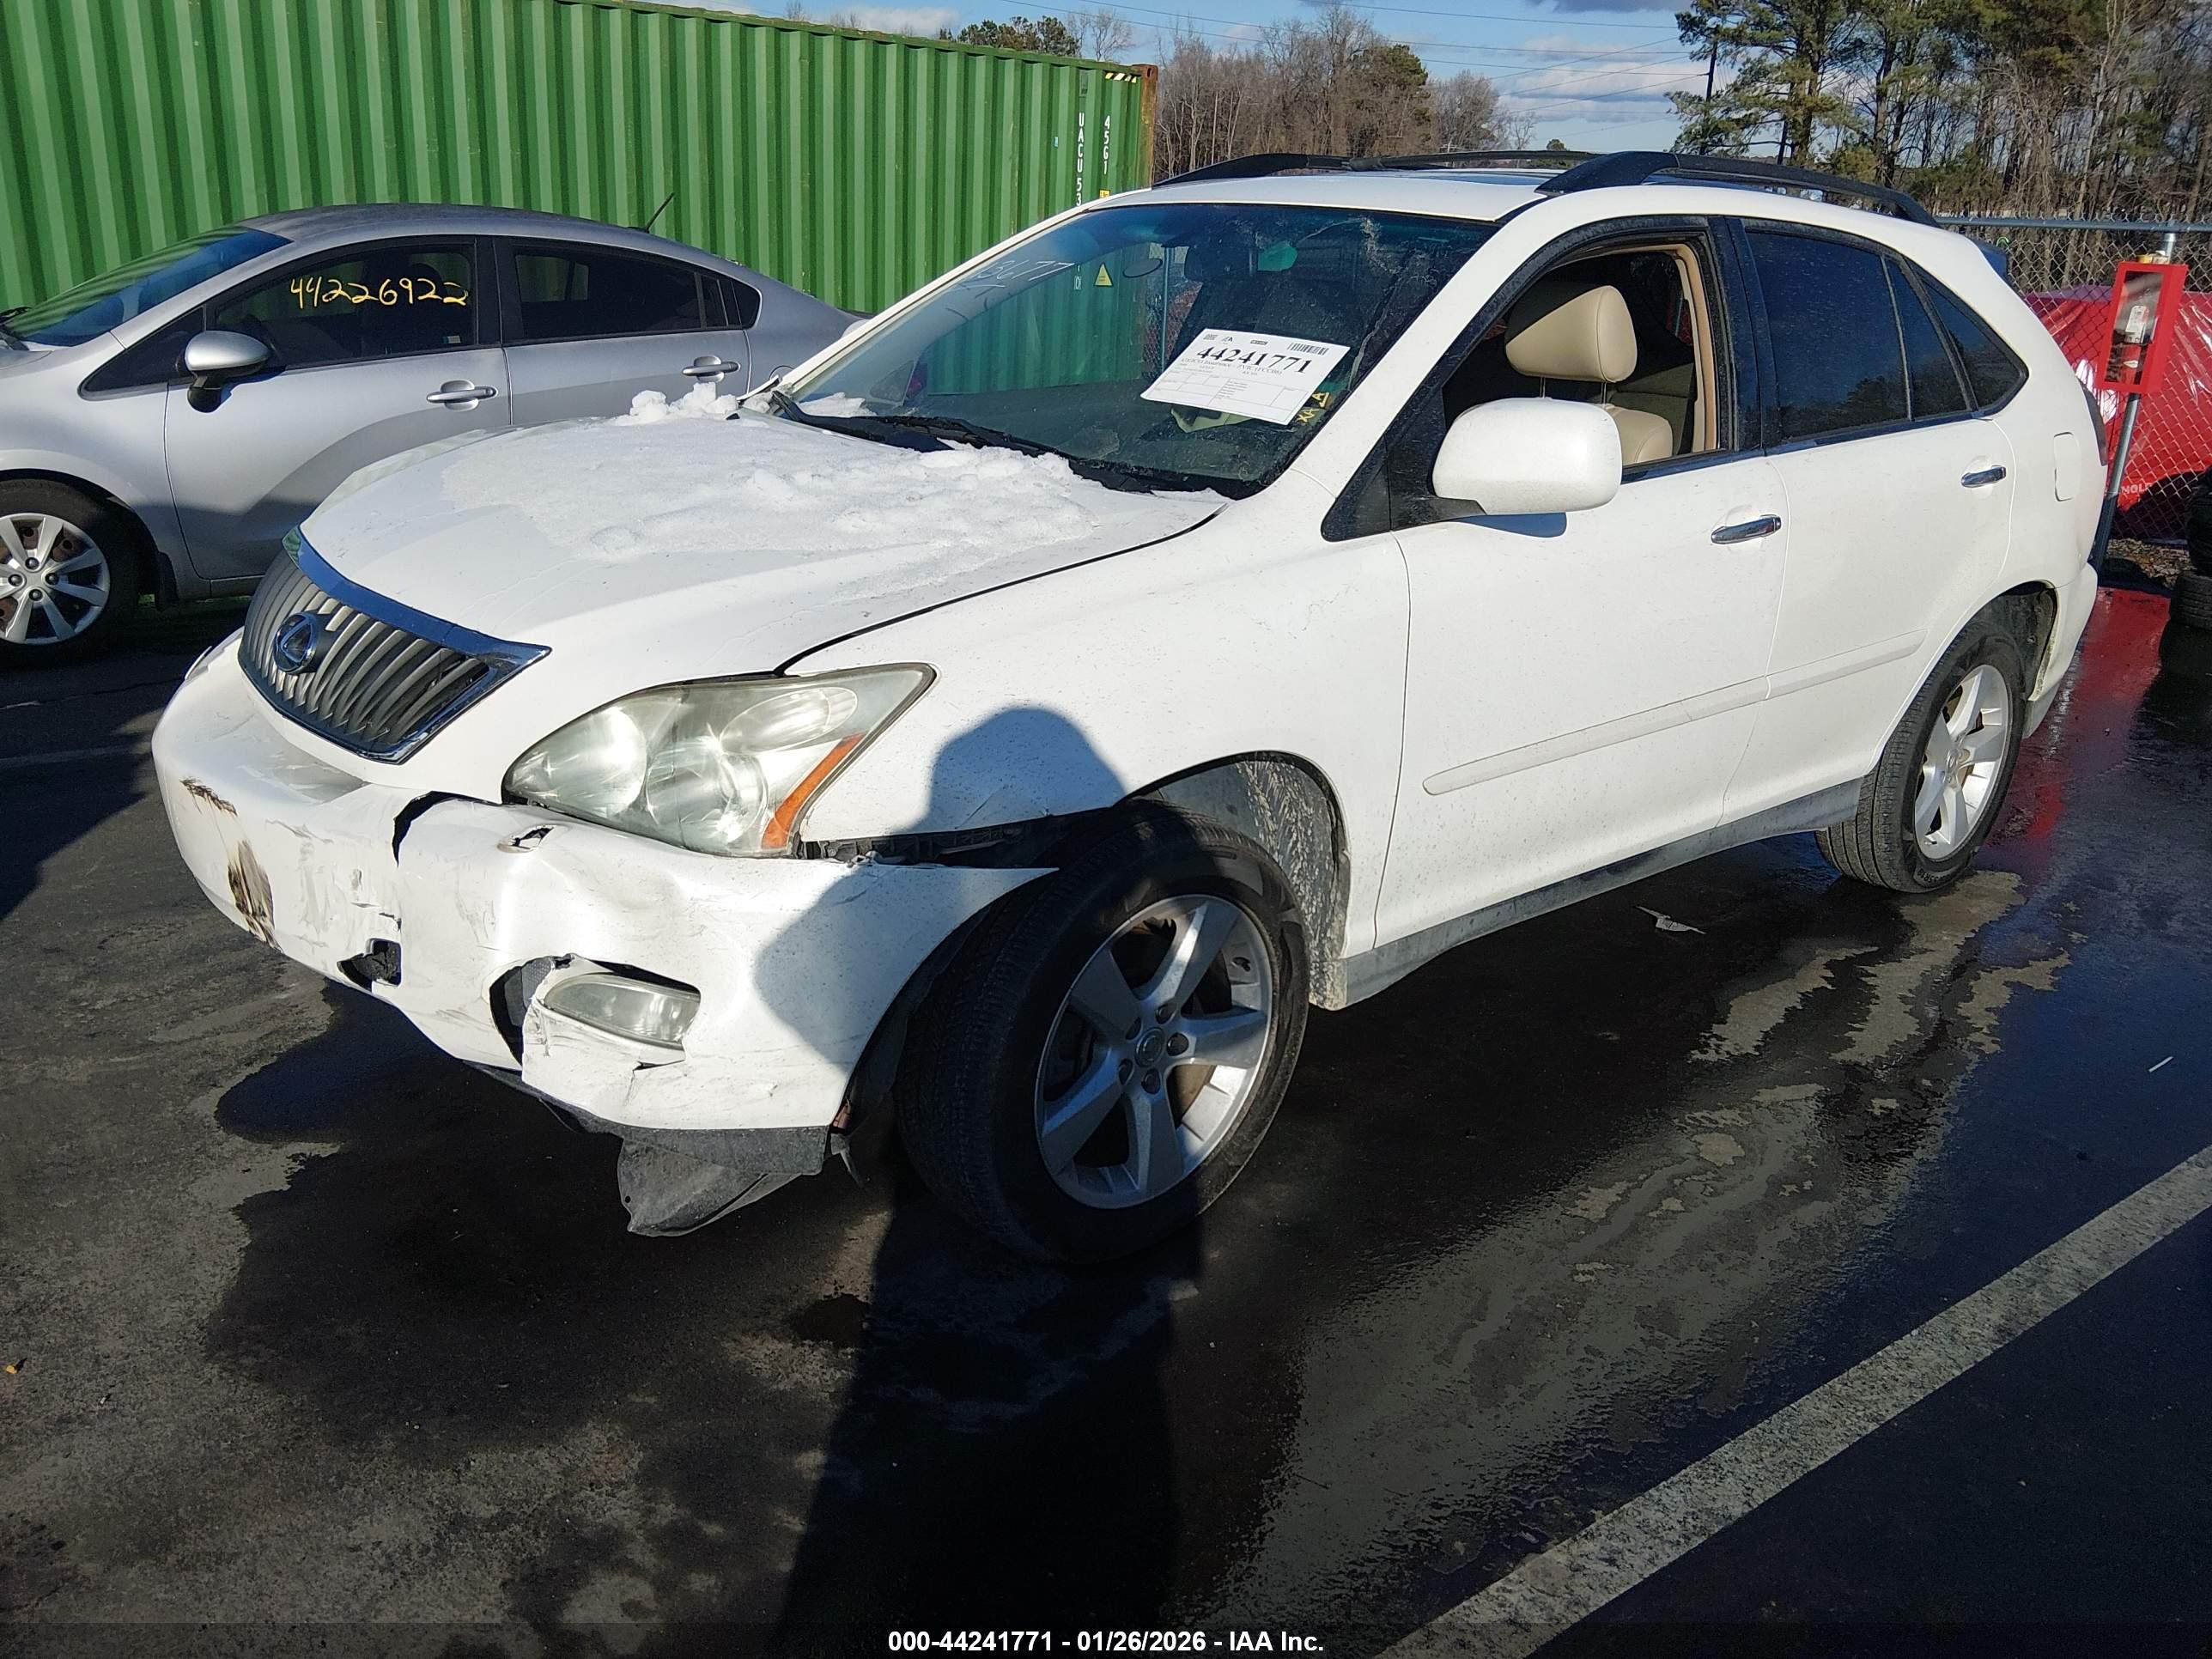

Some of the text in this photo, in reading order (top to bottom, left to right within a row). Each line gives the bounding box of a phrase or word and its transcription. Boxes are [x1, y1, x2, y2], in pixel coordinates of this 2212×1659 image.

[1077, 112, 1085, 173] UACU
[1103, 115, 1111, 175] 45G1
[290, 276, 469, 309] 44226922
[1196, 346, 1313, 374] 44241771
